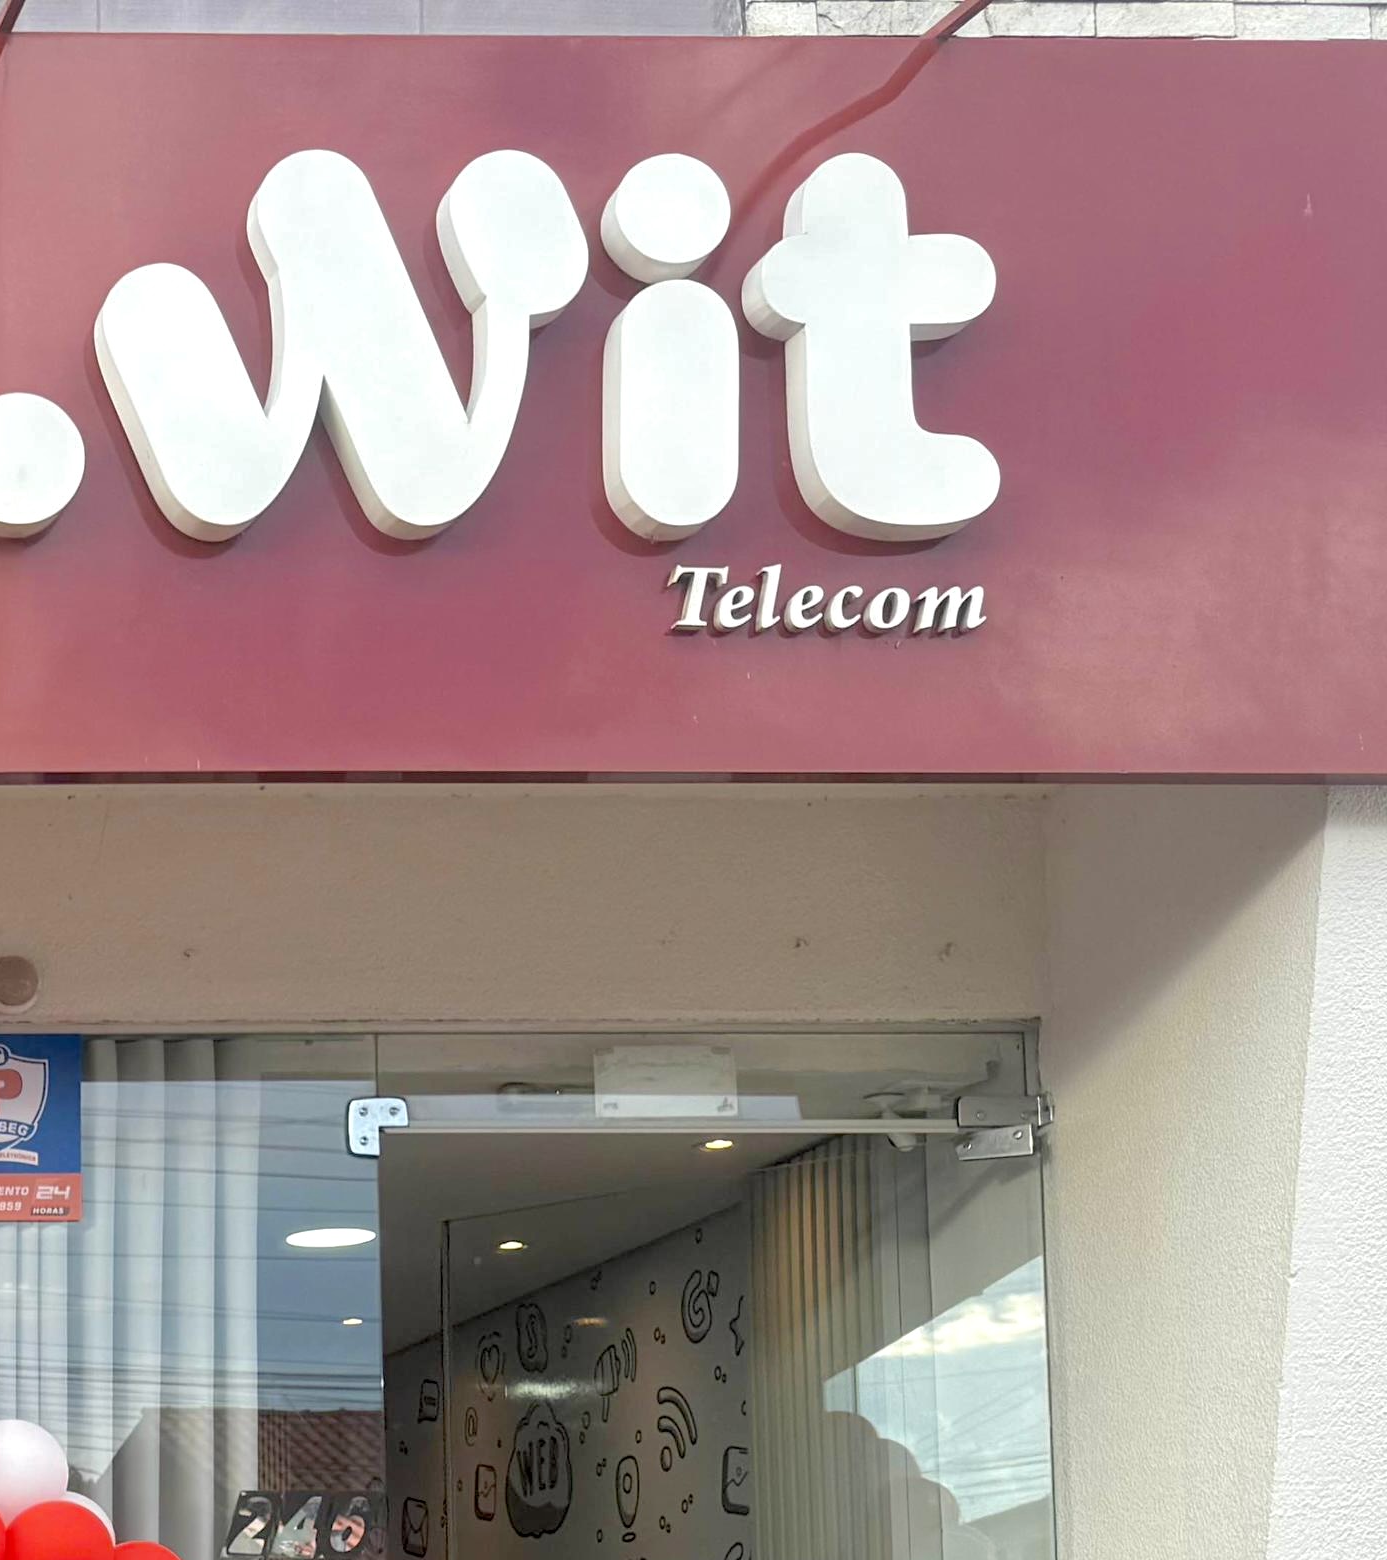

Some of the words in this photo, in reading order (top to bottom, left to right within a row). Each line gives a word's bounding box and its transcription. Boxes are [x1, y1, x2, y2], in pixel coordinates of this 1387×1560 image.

[667, 563, 987, 634] Telecom
[32, 1206, 65, 1216] HORAS
[35, 1184, 72, 1201] 24
[516, 1435, 558, 1498] WEB
